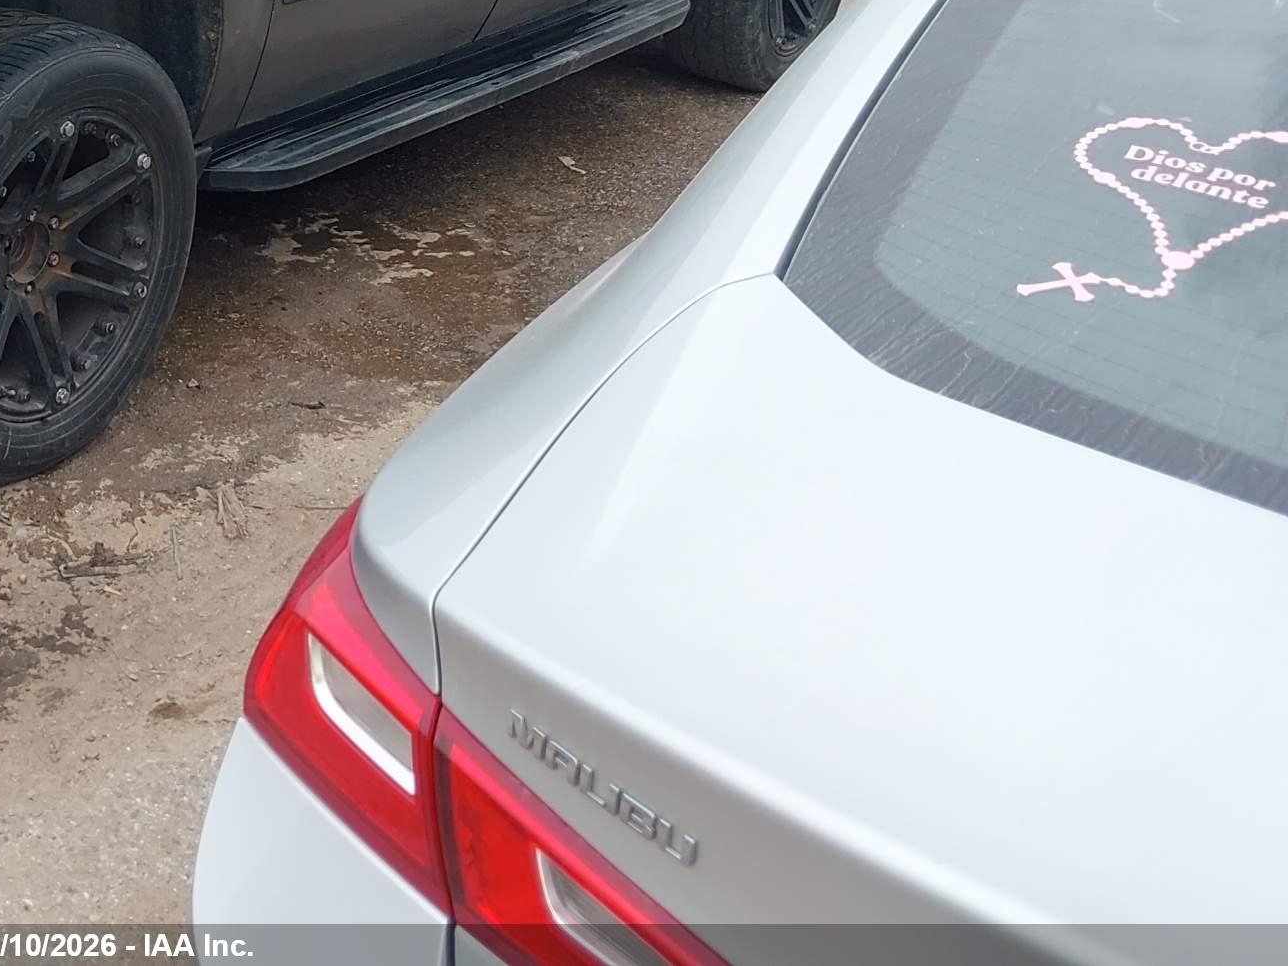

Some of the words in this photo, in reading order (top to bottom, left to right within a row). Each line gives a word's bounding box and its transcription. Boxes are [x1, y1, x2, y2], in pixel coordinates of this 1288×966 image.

[1124, 144, 1208, 174] Dios
[1206, 167, 1276, 191] por
[1130, 165, 1269, 209] delante
[510, 708, 698, 867] MALIBU
